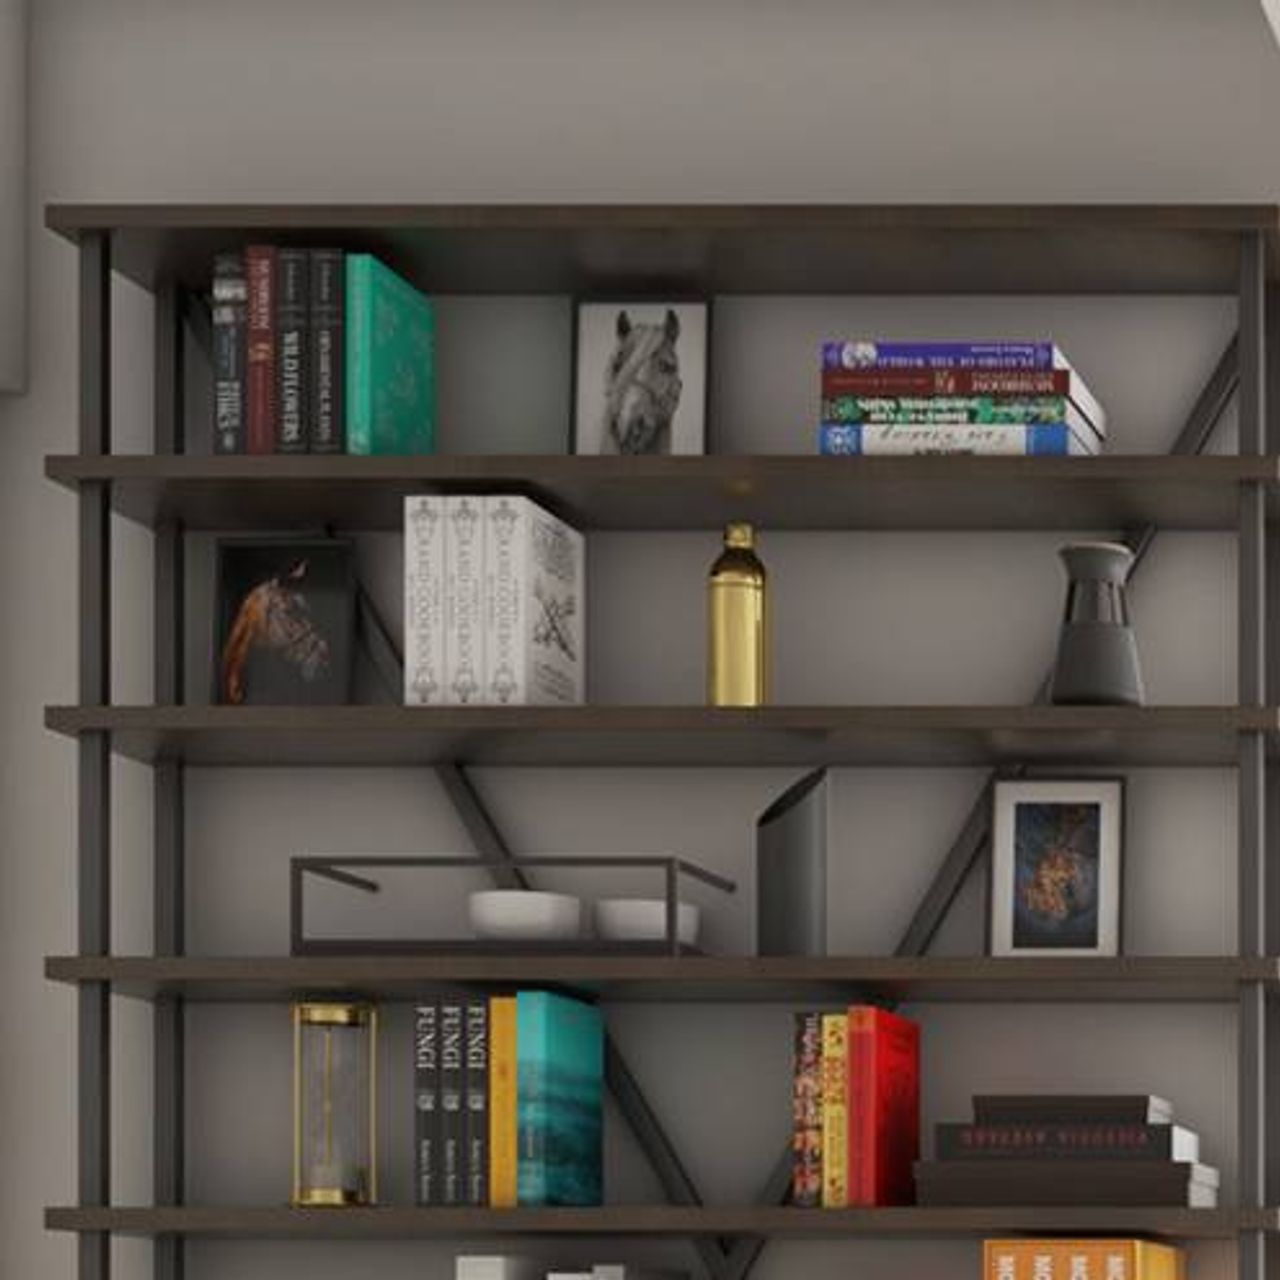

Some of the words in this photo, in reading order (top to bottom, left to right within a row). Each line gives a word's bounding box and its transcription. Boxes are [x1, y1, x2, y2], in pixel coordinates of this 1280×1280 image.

[414, 1006, 435, 1069] FUNGI
[440, 1006, 461, 1069] FUNGI
[467, 1006, 487, 1069] FUNGI
